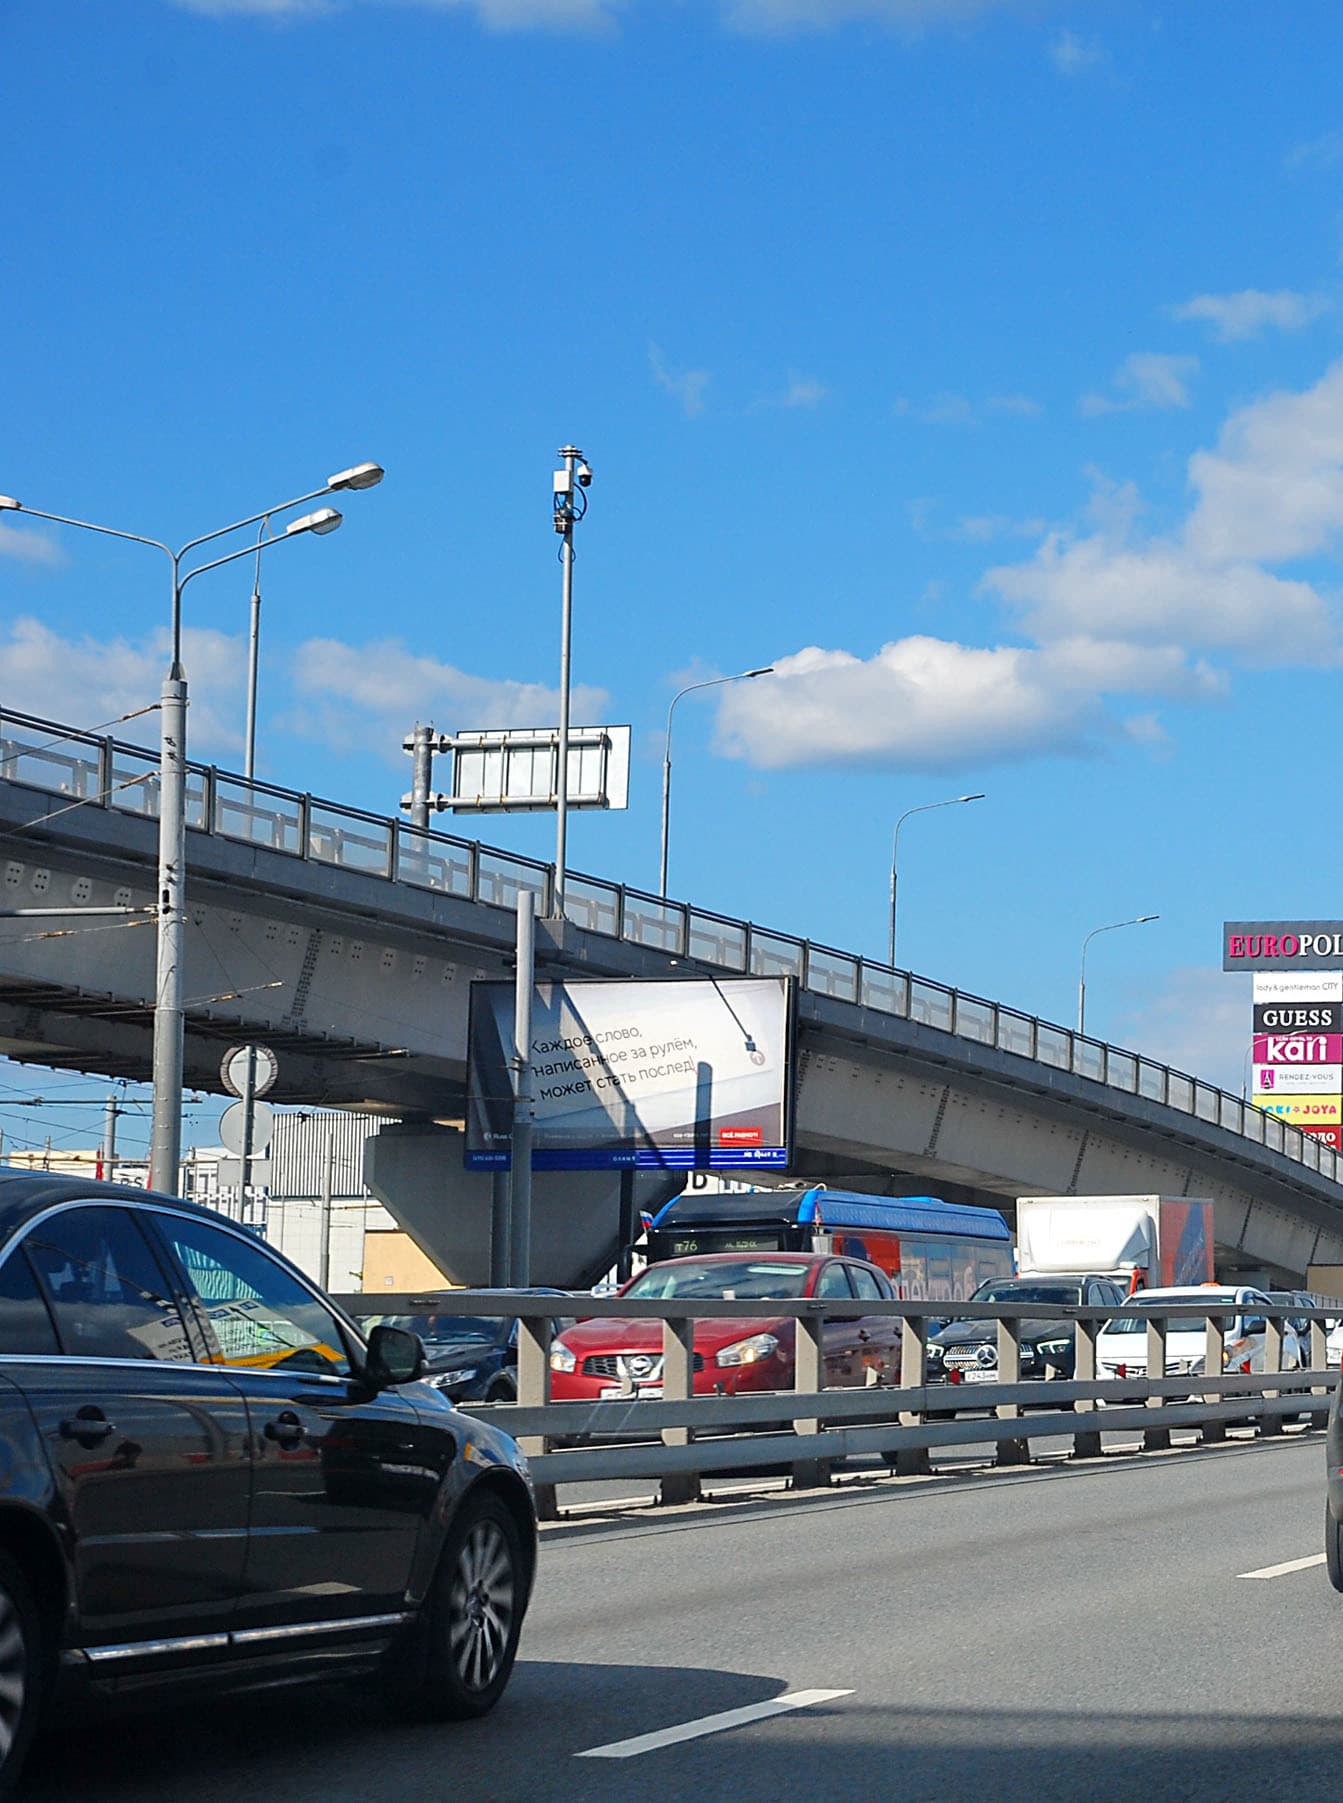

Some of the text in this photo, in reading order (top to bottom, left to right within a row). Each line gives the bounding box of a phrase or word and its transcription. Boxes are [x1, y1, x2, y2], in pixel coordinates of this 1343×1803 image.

[1321, 982, 1339, 991] CITY
[1263, 1009, 1332, 1027] GUESS
[595, 1026, 643, 1045] слово,
[533, 1036, 698, 1078] написанное за рулём,
[1267, 1036, 1327, 1061] kari
[540, 1079, 593, 1101] может
[596, 1073, 637, 1090] стать
[1303, 1104, 1337, 1115] JOYA
